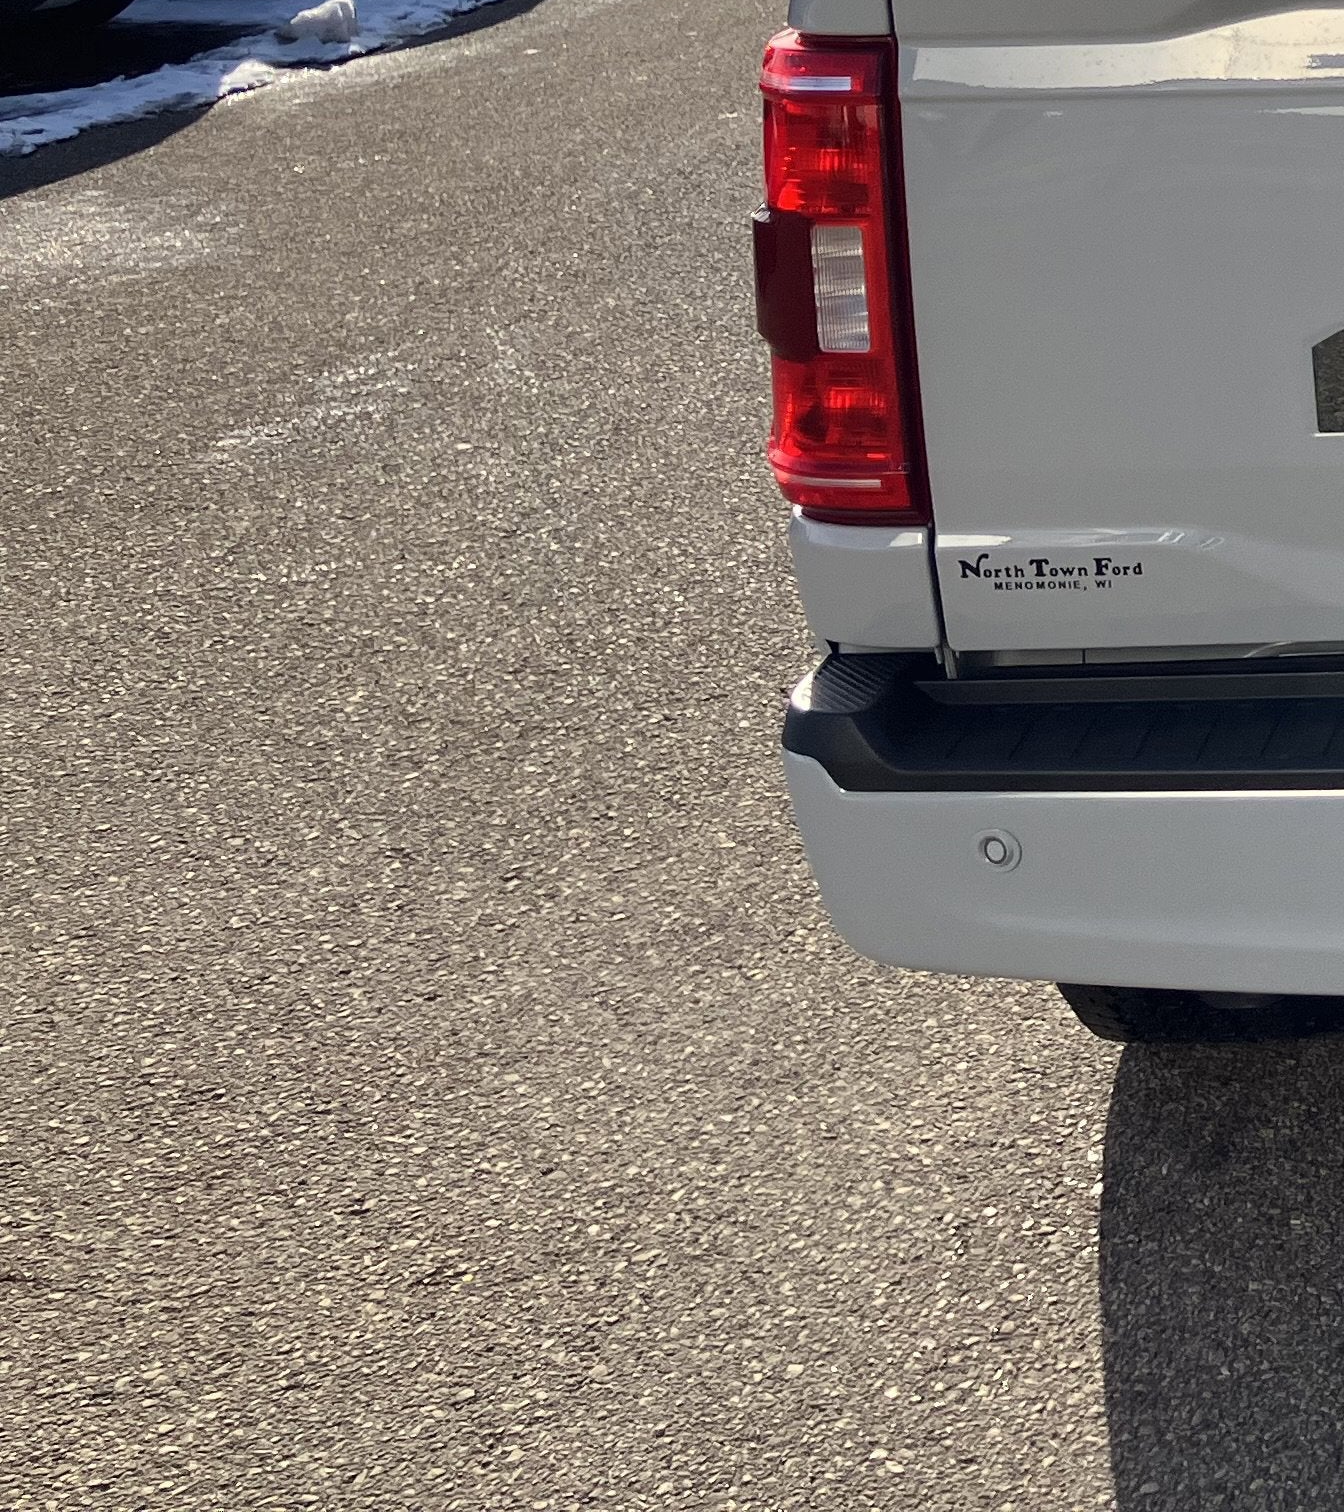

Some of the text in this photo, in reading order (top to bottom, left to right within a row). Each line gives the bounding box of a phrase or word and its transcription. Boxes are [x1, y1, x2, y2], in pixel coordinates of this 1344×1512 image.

[958, 553, 1143, 579] North Town Ford
[994, 579, 1113, 592] MENOMONIE, WI
